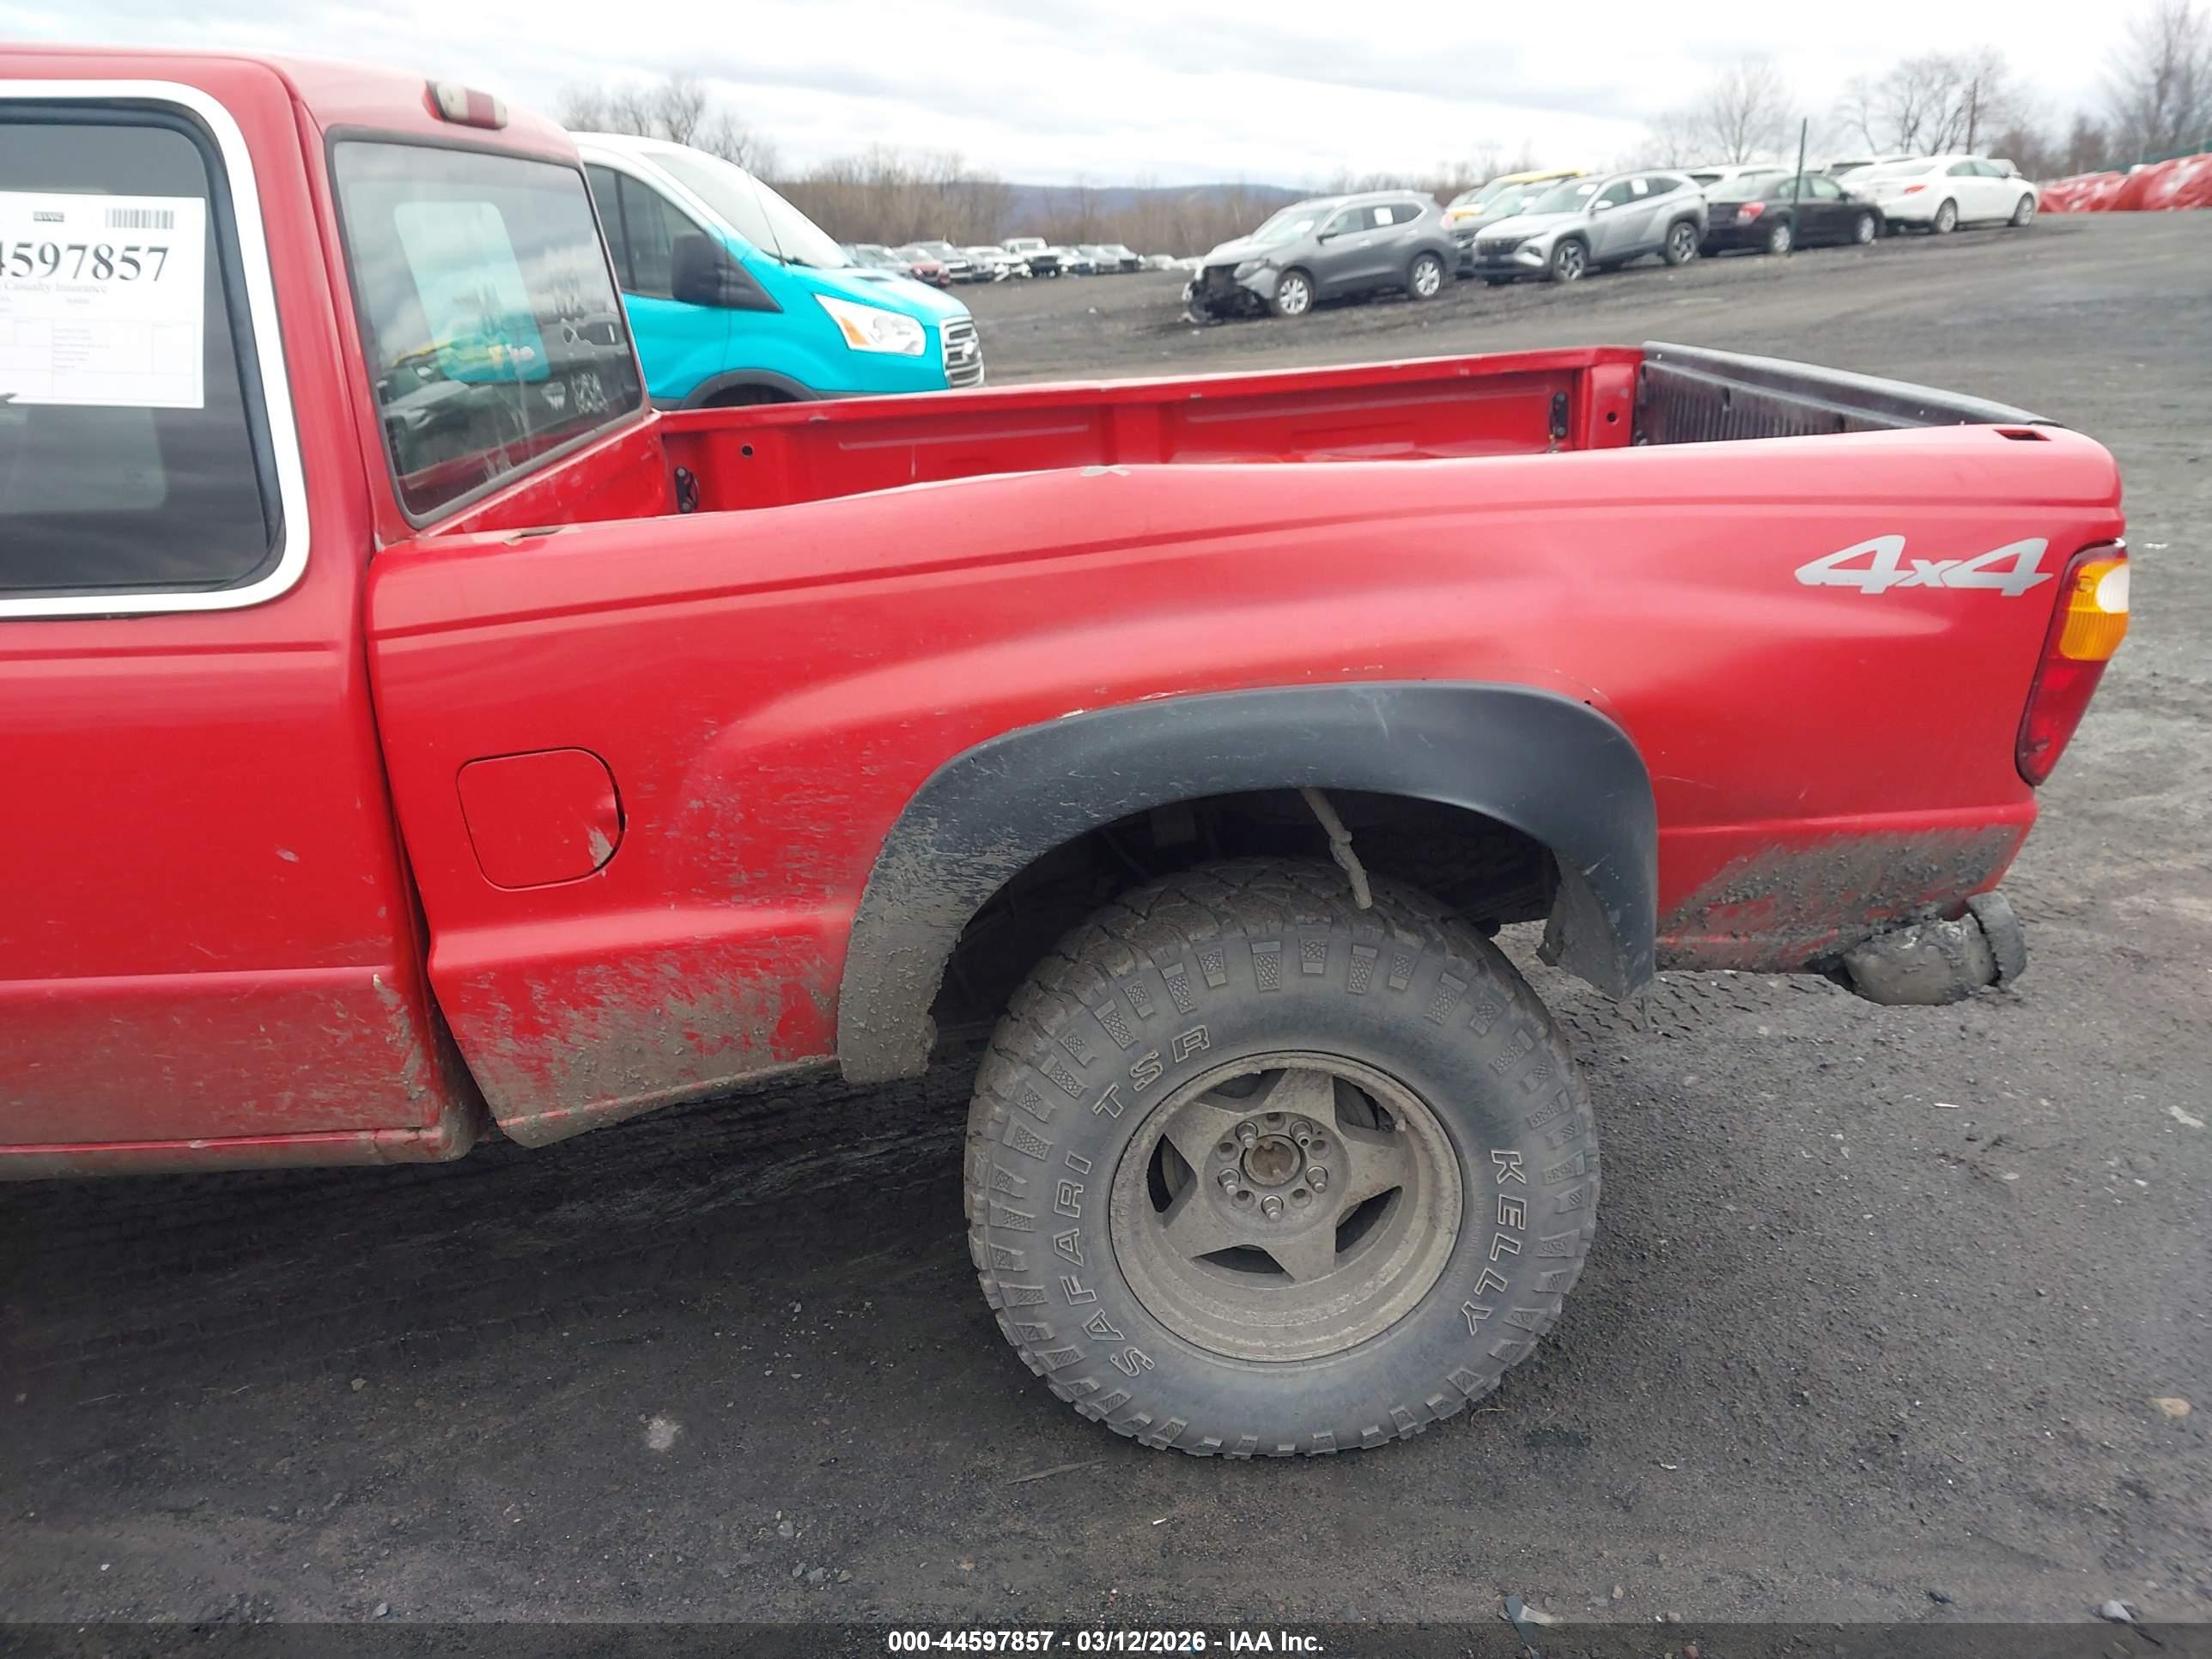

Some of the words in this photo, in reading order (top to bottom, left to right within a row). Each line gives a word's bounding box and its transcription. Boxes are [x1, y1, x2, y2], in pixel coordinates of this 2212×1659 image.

[0, 240, 168, 282] 597857
[1794, 534, 2054, 596] 4x4
[1091, 1024, 1211, 1119] TSR
[1052, 1150, 1156, 1377] SAFARI
[1461, 1150, 1527, 1337] KELLY
